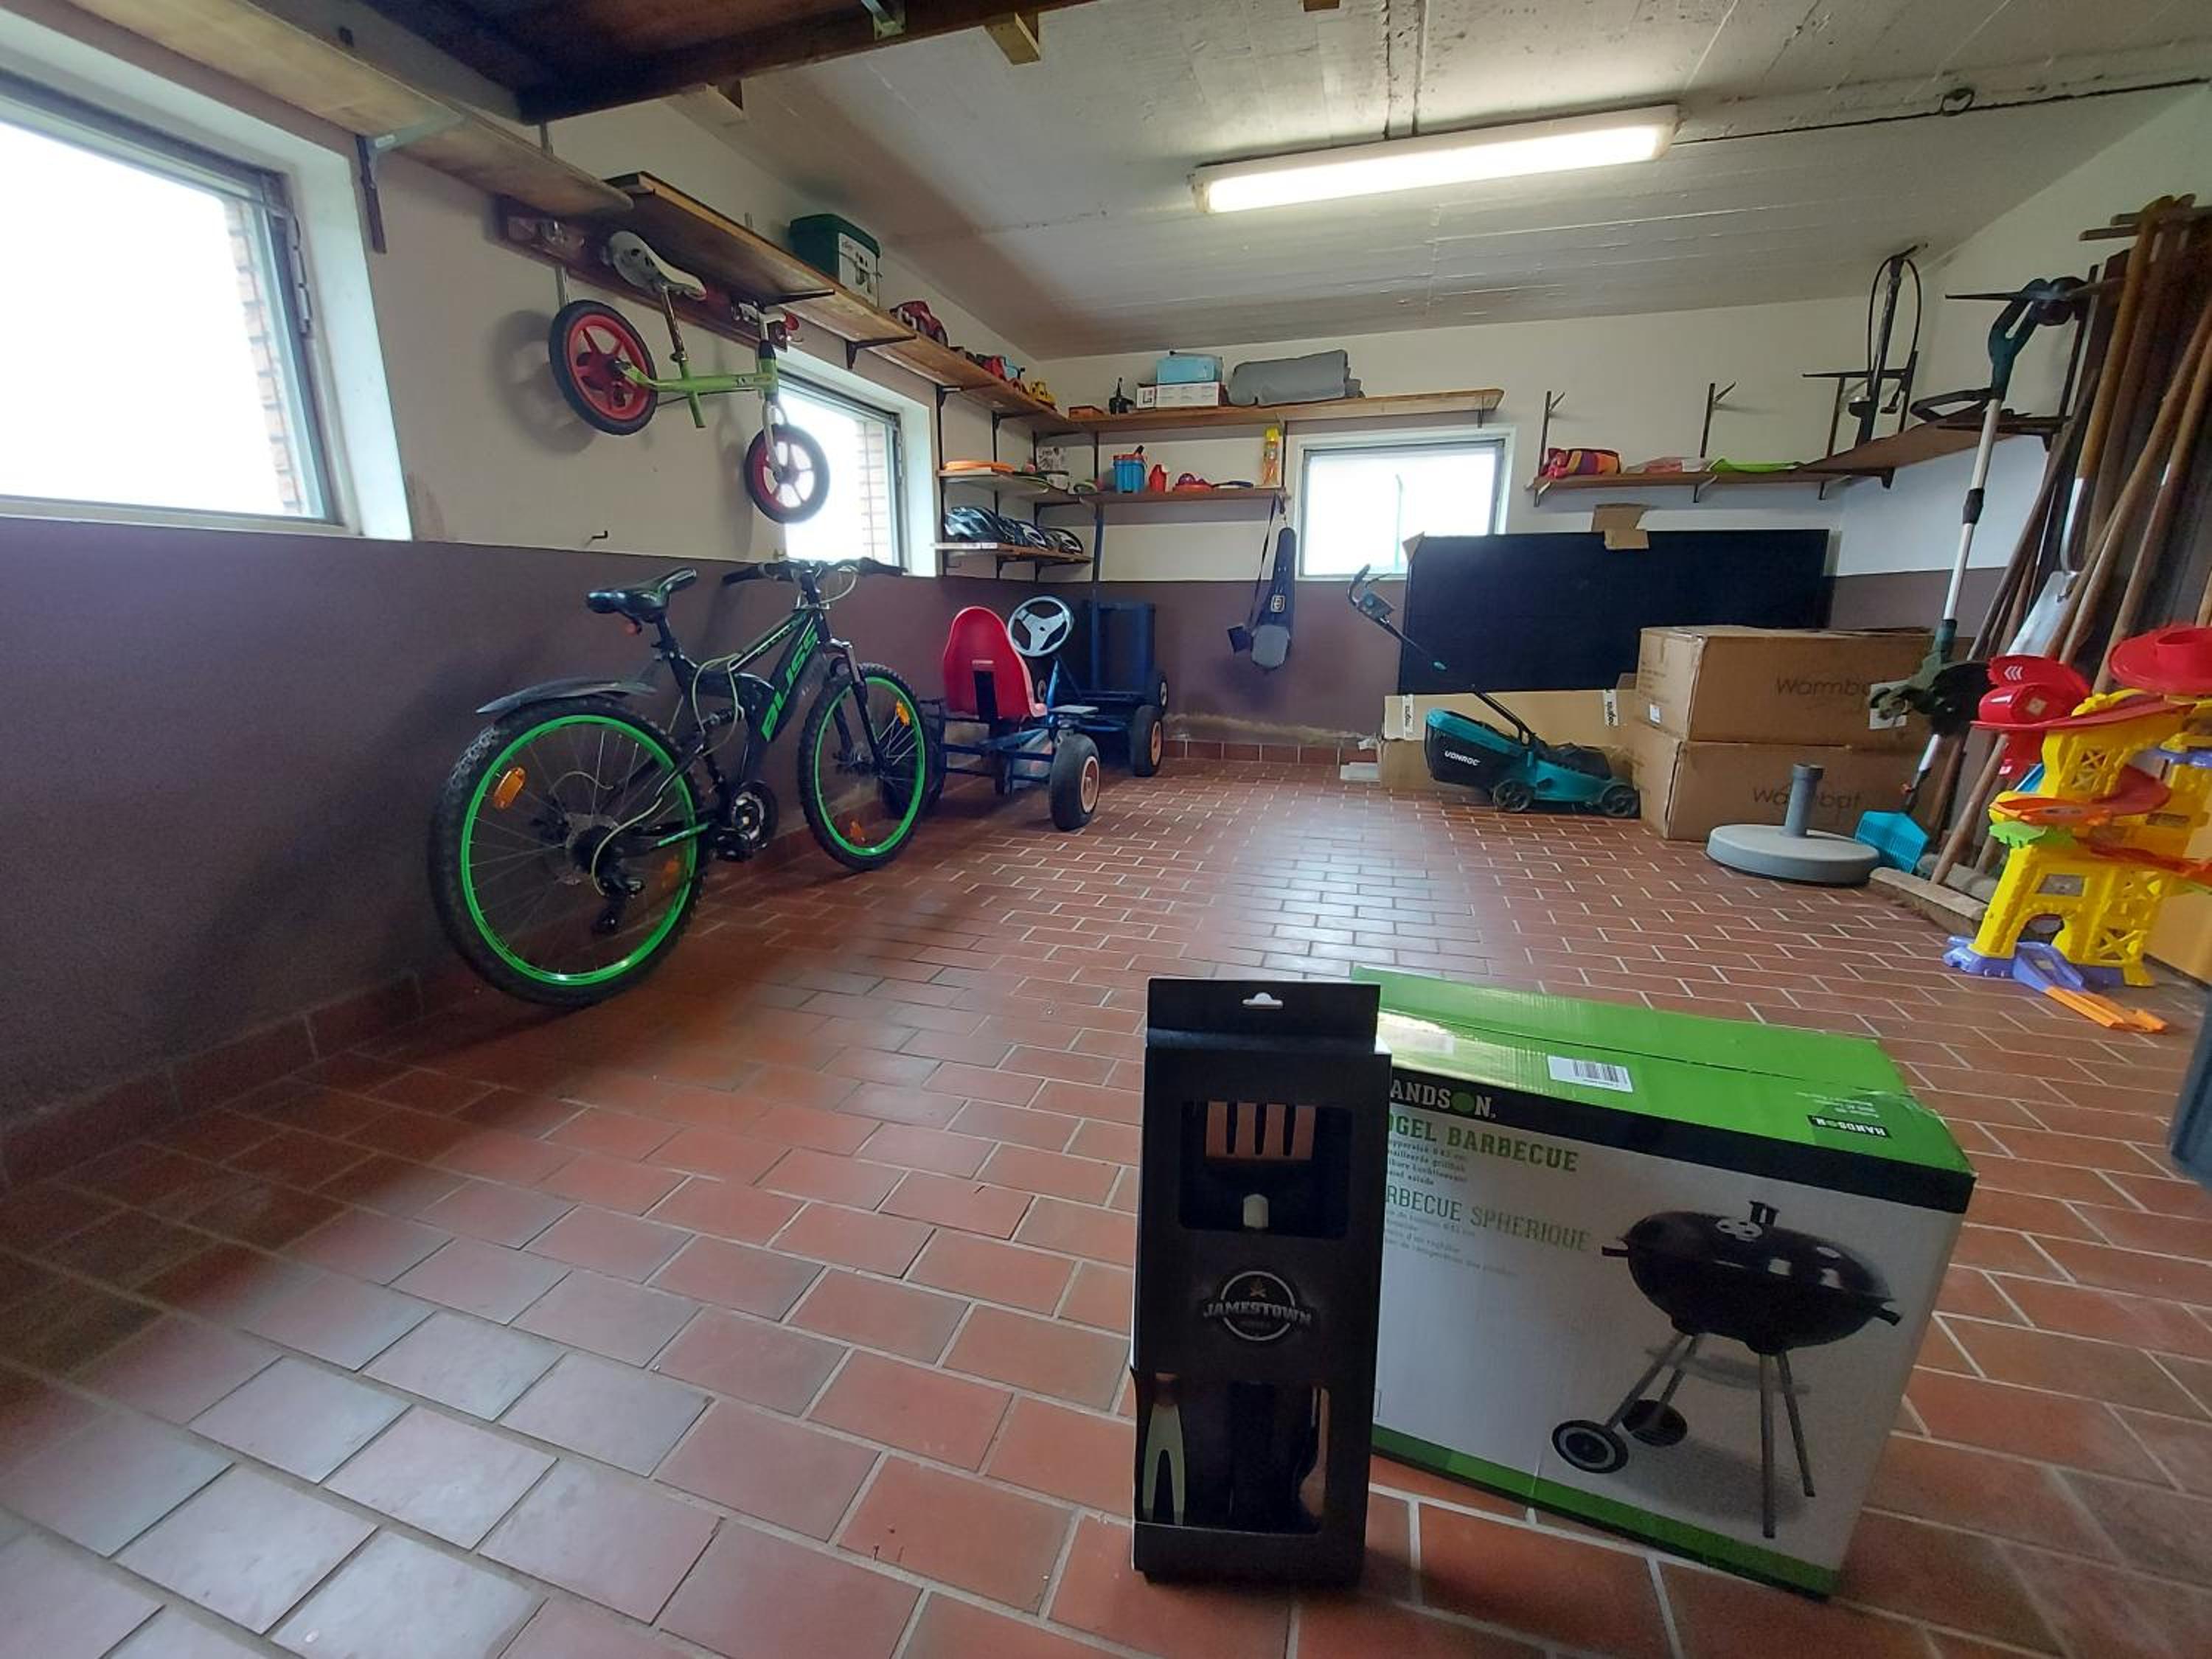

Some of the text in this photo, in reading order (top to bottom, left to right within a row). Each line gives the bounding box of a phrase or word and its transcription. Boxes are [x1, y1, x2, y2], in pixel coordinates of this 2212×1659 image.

[1444, 750, 1481, 766] VONROC
[1753, 785, 1862, 810] Wabat
[1389, 1114, 1437, 1142] GEL
[1447, 1126, 1579, 1172] BARBECUE
[1385, 1184, 1463, 1222] RBECUE
[1470, 1204, 1591, 1251] SPHERIQUE
[1203, 1300, 1312, 1325] JAMESTOWN
